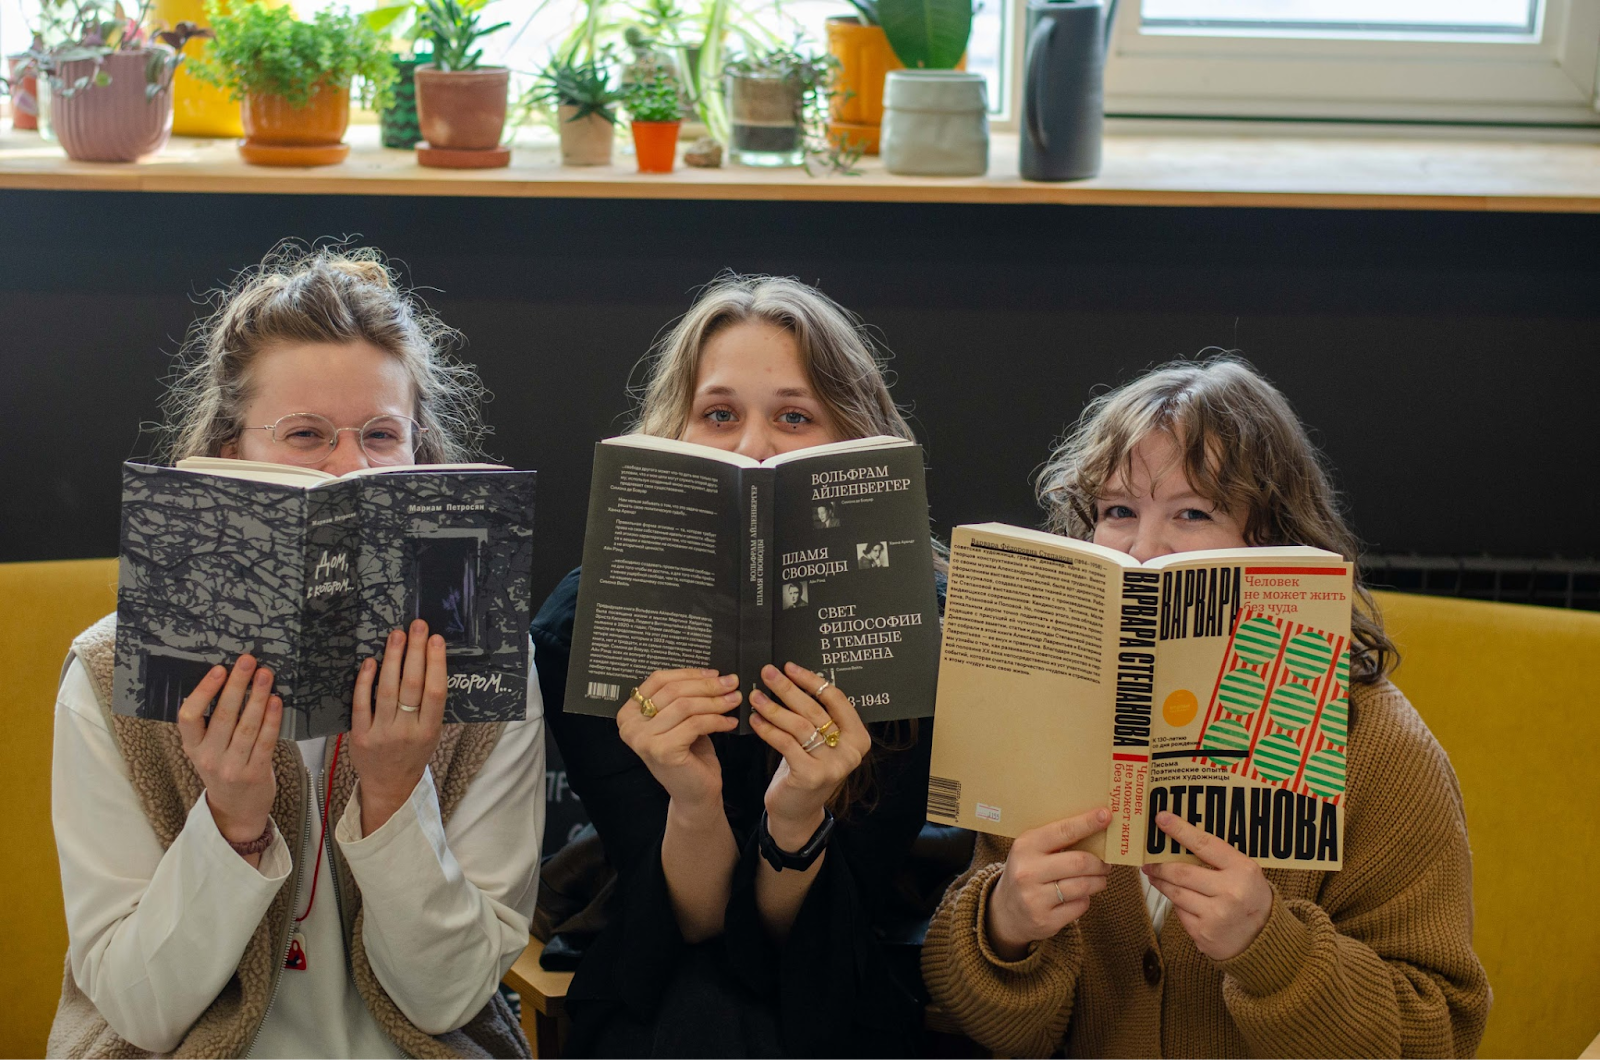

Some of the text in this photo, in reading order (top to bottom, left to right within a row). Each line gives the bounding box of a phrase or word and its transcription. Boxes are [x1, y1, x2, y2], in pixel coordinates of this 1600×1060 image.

[811, 465, 889, 486] ВОЛЬФРАМ
[811, 478, 911, 500] АЙЛЕНБЕРГЕР
[409, 503, 485, 513] Мариам Петросян
[315, 550, 349, 580] Дом,
[782, 547, 829, 566] ПЛАМЯ
[782, 560, 849, 581] СВОБОДЫ
[1244, 575, 1300, 587] Человек
[1159, 567, 1241, 641] ВАРВАРА
[1244, 591, 1346, 601] не может жить
[818, 604, 857, 620] СВЕТ
[1243, 601, 1298, 615] без чуда
[819, 613, 922, 635] ФИЛОСОФИИ
[820, 630, 903, 650] В ТЕМНЫЕ
[822, 646, 894, 665] ВРЕМЕНА
[1113, 571, 1160, 747] ВАРВАРА СТЕПАНОВА
[447, 673, 512, 695] отором...
[847, 692, 890, 708] 3-1943
[1151, 767, 1199, 775] Поэтические
[1110, 763, 1125, 813] без чуда
[1134, 765, 1147, 815] Человек
[1120, 764, 1134, 856] не может жить
[1146, 785, 1338, 862] СТЕПАНОВА
